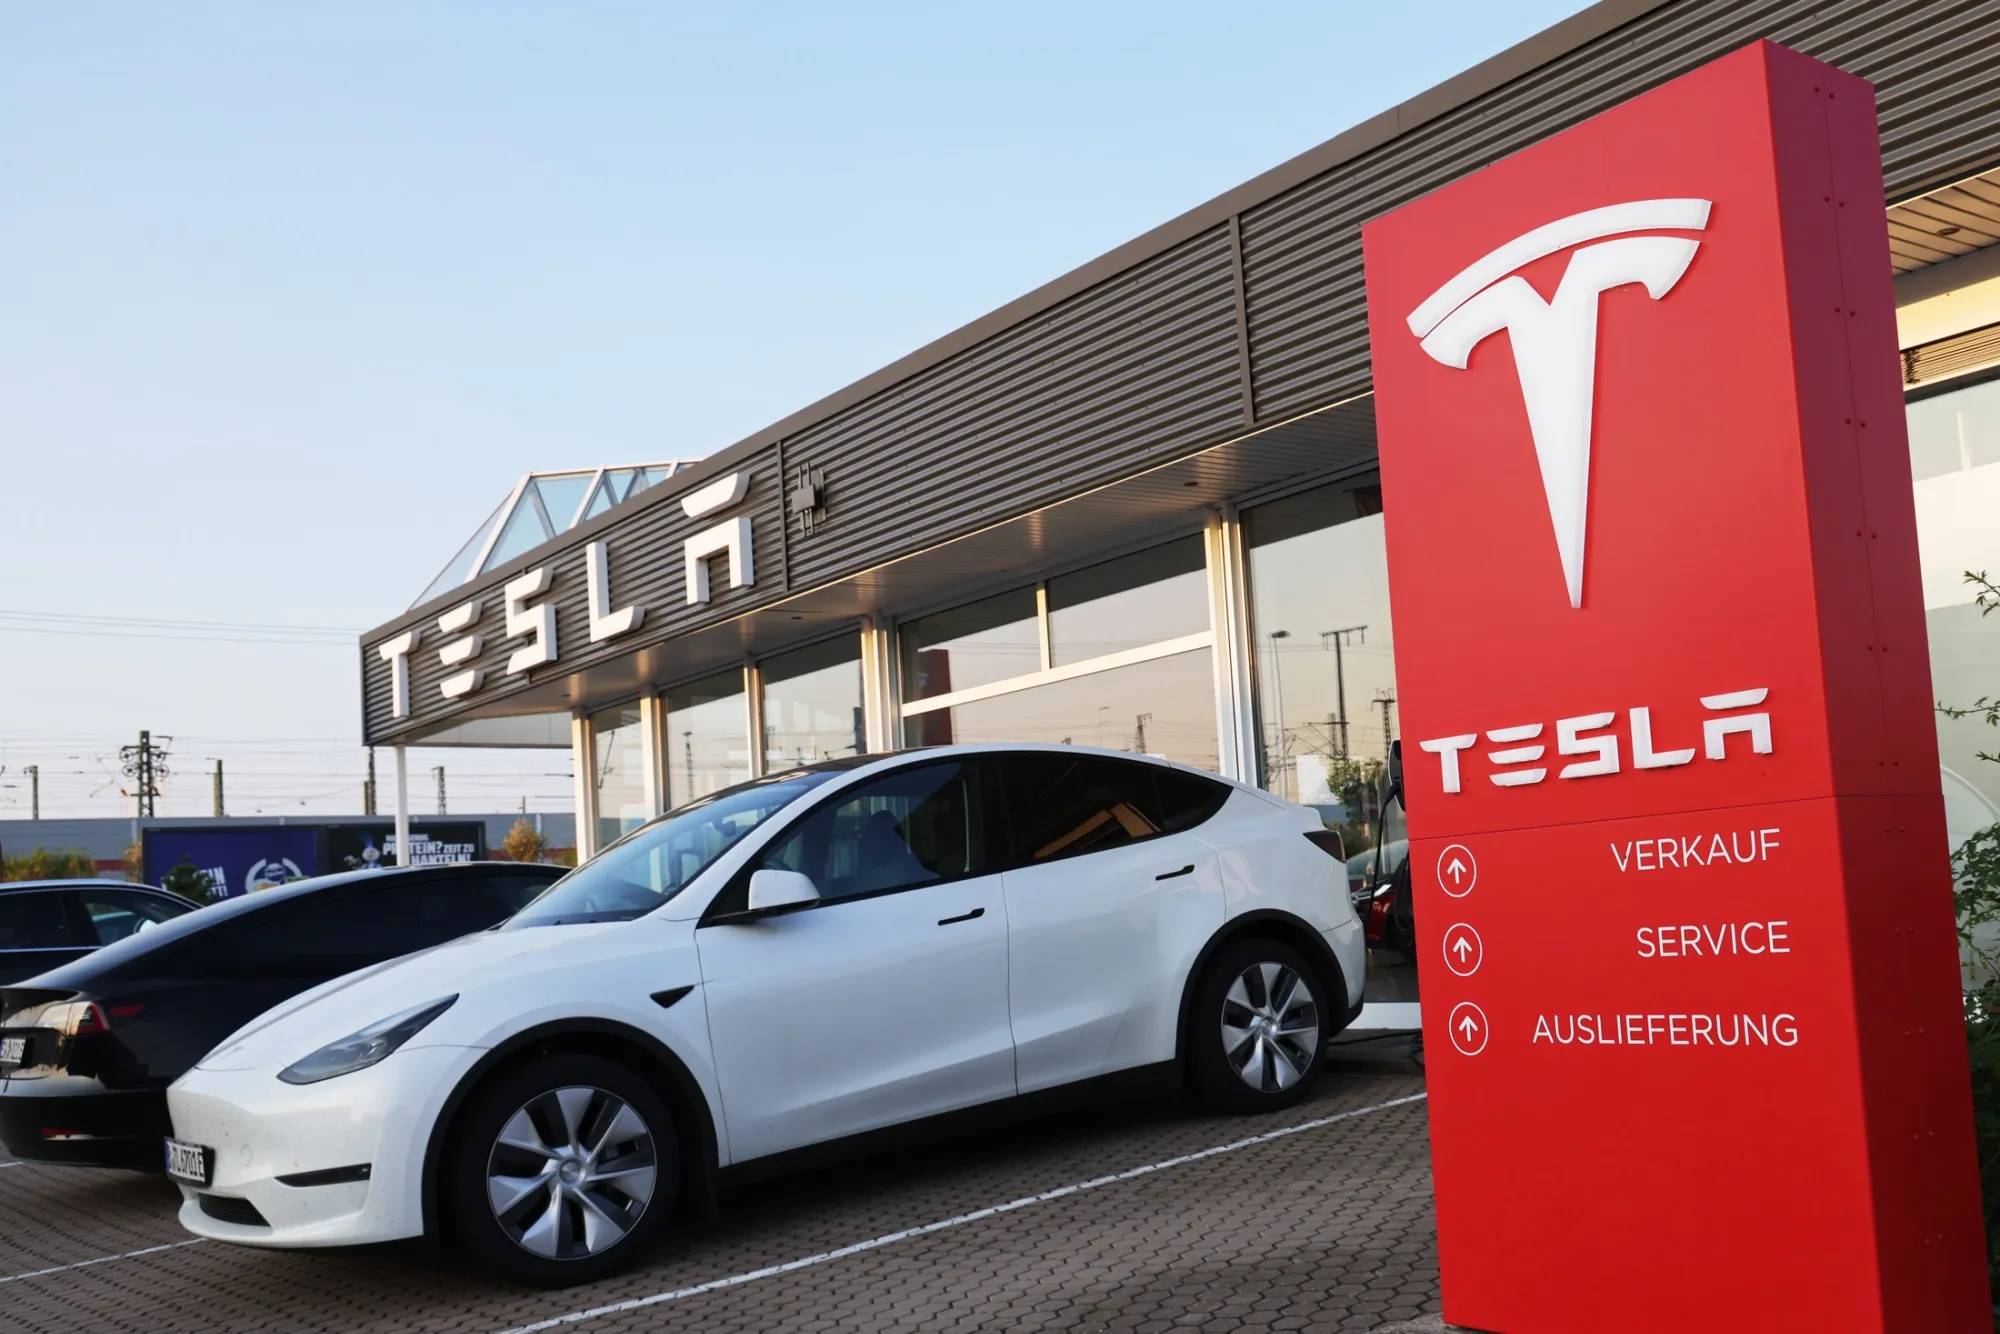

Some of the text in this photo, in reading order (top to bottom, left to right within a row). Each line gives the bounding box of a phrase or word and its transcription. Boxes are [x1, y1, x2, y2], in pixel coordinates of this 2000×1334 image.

[379, 472, 755, 718] TESLA
[1419, 687, 1773, 793] TESLA
[382, 840, 443, 856] PRTEIN?
[443, 843, 461, 854] ZEIT
[1610, 828, 1780, 872] VERKAUF
[1637, 920, 1790, 958] SERVICE
[1533, 1013, 1798, 1046] AUSLIEFERUNG
